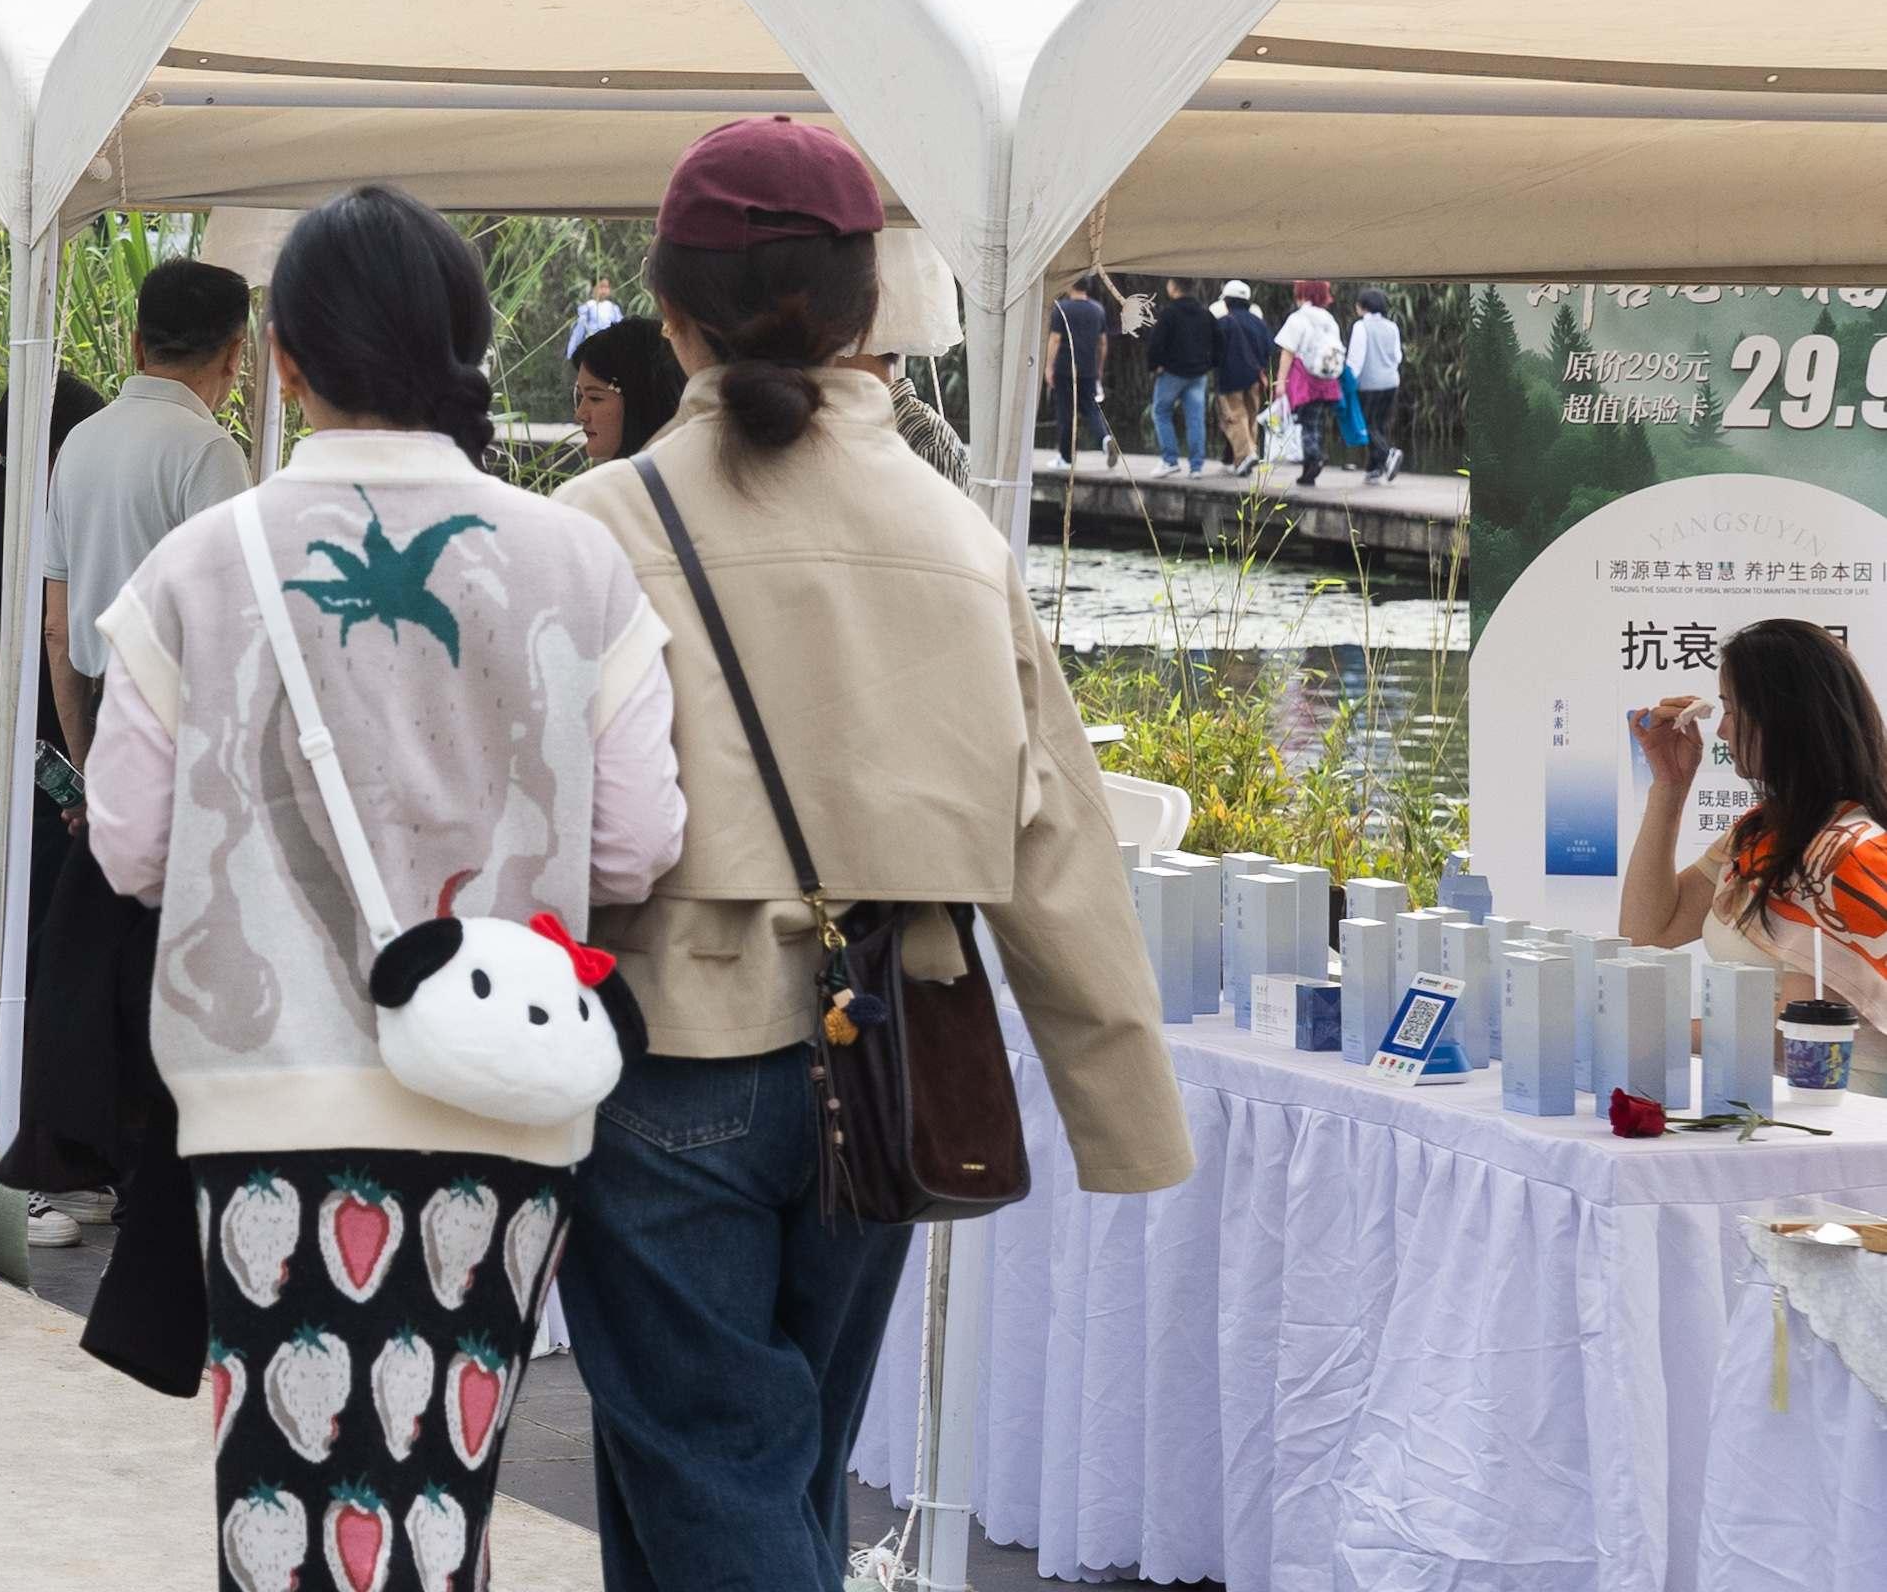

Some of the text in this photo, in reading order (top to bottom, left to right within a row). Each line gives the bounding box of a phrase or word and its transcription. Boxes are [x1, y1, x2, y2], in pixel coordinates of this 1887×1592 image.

[1562, 349, 1711, 385] 原价298元
[1560, 393, 1710, 425] 超值体验卡
[1610, 559, 1873, 583] 溯源草本智慧 养护生命本因
[1656, 586, 1683, 594] SOURCE
